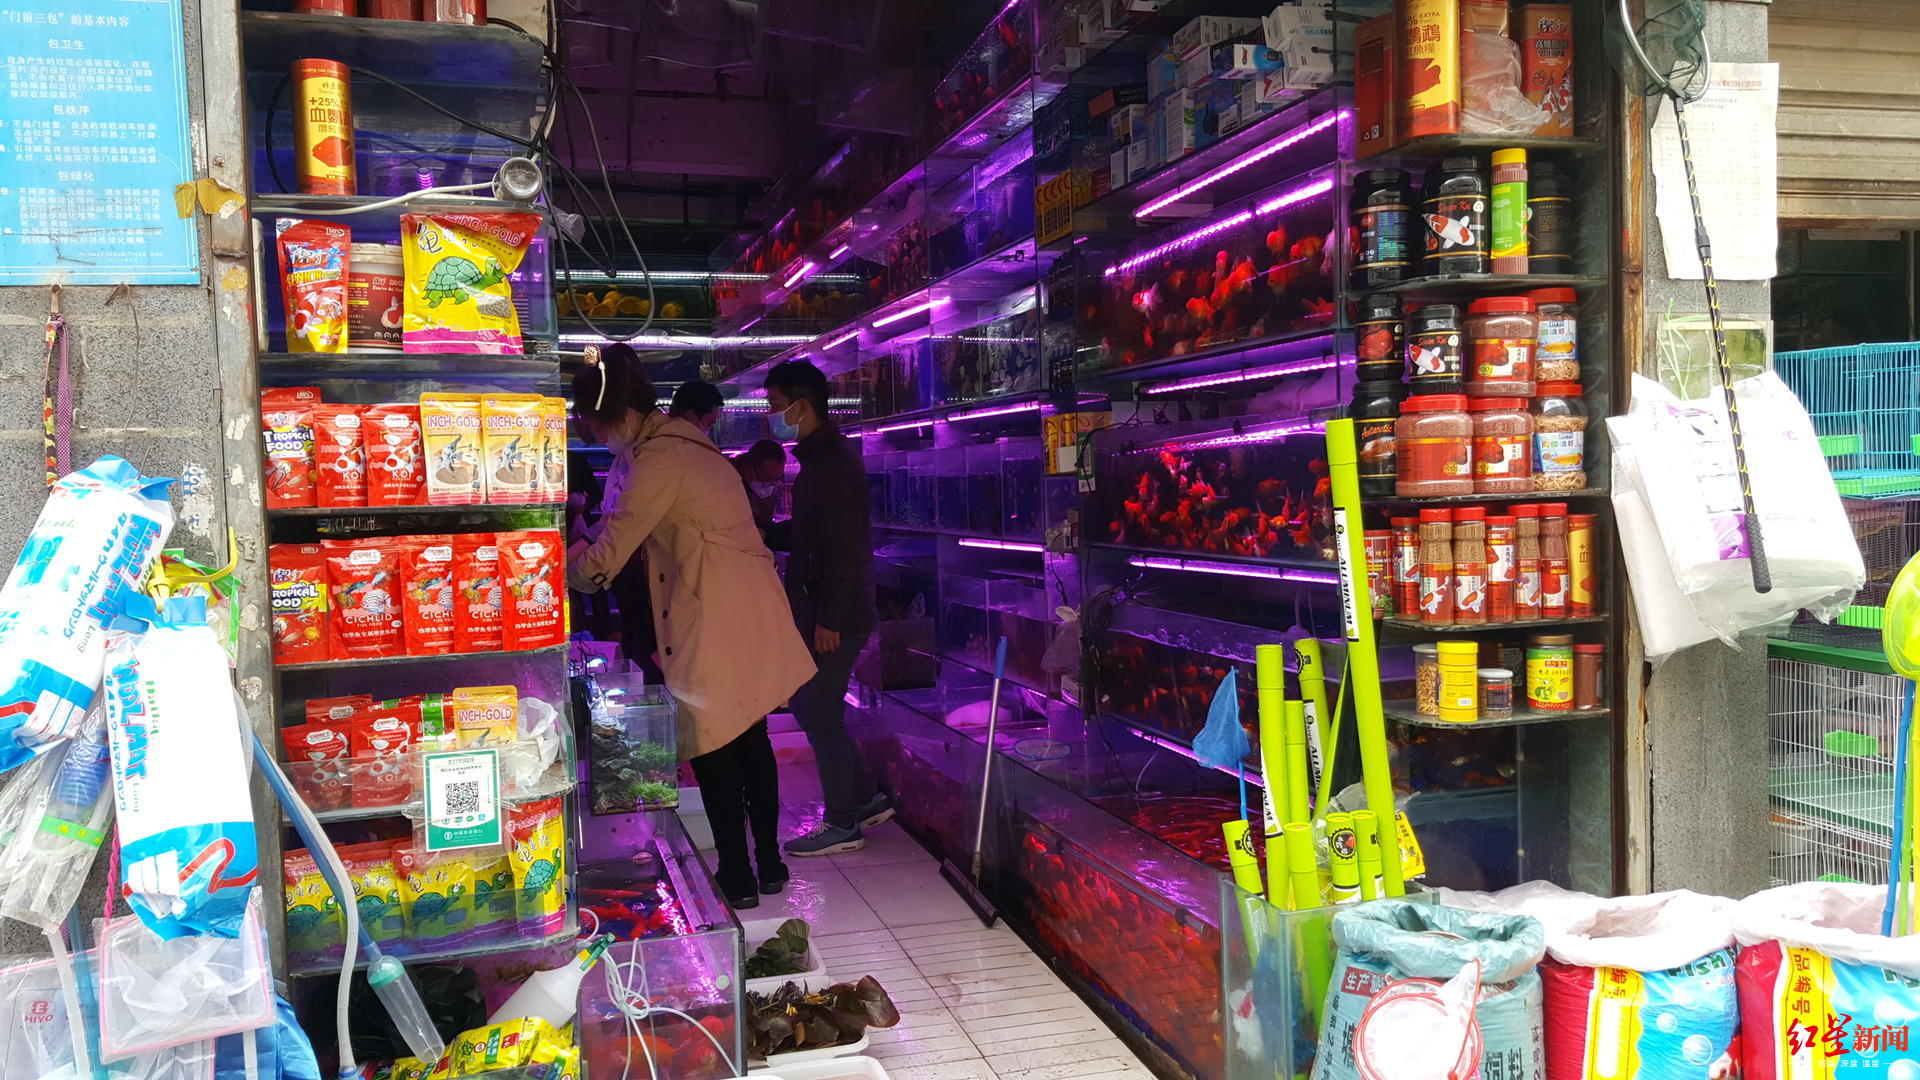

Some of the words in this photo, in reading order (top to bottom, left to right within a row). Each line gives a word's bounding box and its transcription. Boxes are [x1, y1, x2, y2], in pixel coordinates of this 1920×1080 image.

[48, 38, 85, 50] 包卫生
[53, 104, 91, 115] 包秩序
[58, 170, 95, 182] 包绿化
[426, 415, 481, 429] INCH-GOLD
[488, 415, 541, 429] INCH-GOLD
[266, 441, 303, 454] FOOD
[271, 583, 319, 598] ROPICAL
[1338, 553, 1353, 628] ALUMINUM
[271, 597, 302, 609] OOD
[422, 610, 454, 620] CICHL
[471, 610, 503, 619] CICHL
[518, 605, 554, 615] CICHLID
[345, 614, 392, 625] CICHLID
[457, 708, 513, 722] INCH-GOLD
[1793, 954, 1813, 1015] 品编号
[24, 1014, 54, 1024] HIYO
